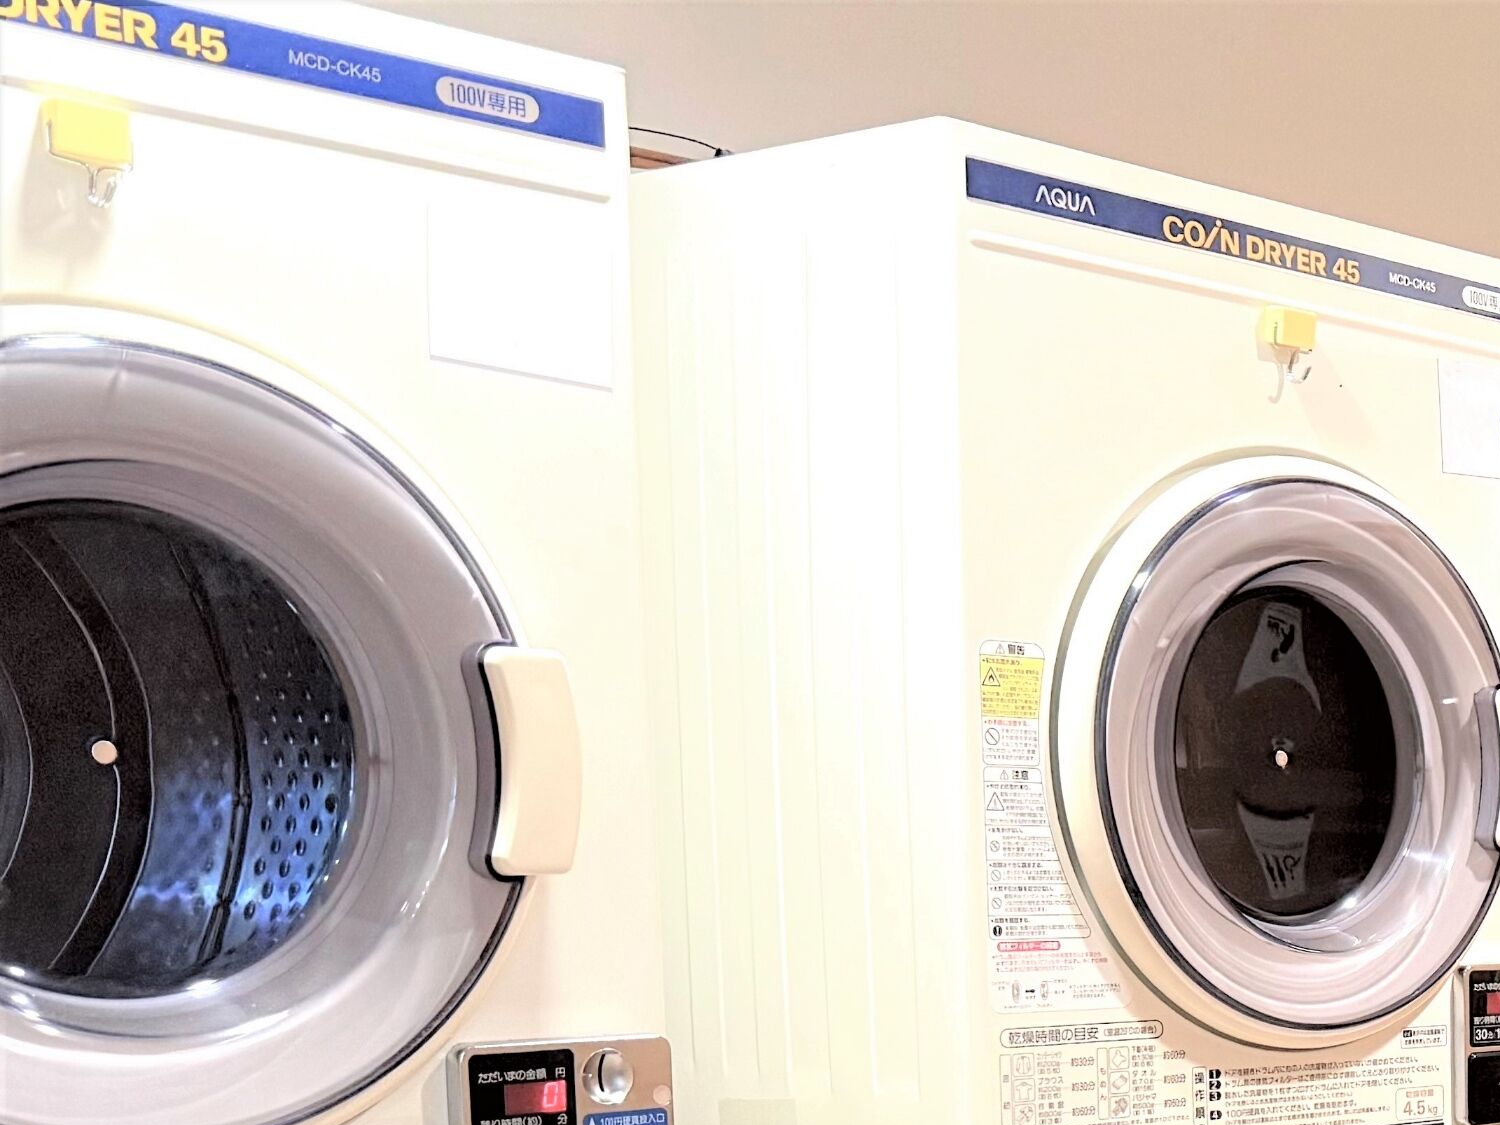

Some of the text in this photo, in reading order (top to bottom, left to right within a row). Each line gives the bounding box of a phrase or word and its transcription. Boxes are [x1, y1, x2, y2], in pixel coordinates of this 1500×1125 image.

[171, 22, 228, 63] 45
[288, 49, 381, 82] MCD-CK45
[449, 82, 526, 117] 100V専用
[1036, 185, 1095, 216] AQUA
[1246, 235, 1327, 276] DRYER
[1333, 258, 1360, 284] 45
[1389, 272, 1437, 293] MCD-CK45
[1008, 1027, 1099, 1045] 乾燥時間の目安
[478, 1066, 566, 1085] ただいまの金額 円
[543, 1081, 559, 1109] 0
[1402, 1100, 1438, 1117] 4.5 kg
[556, 1113, 568, 1125] 分
